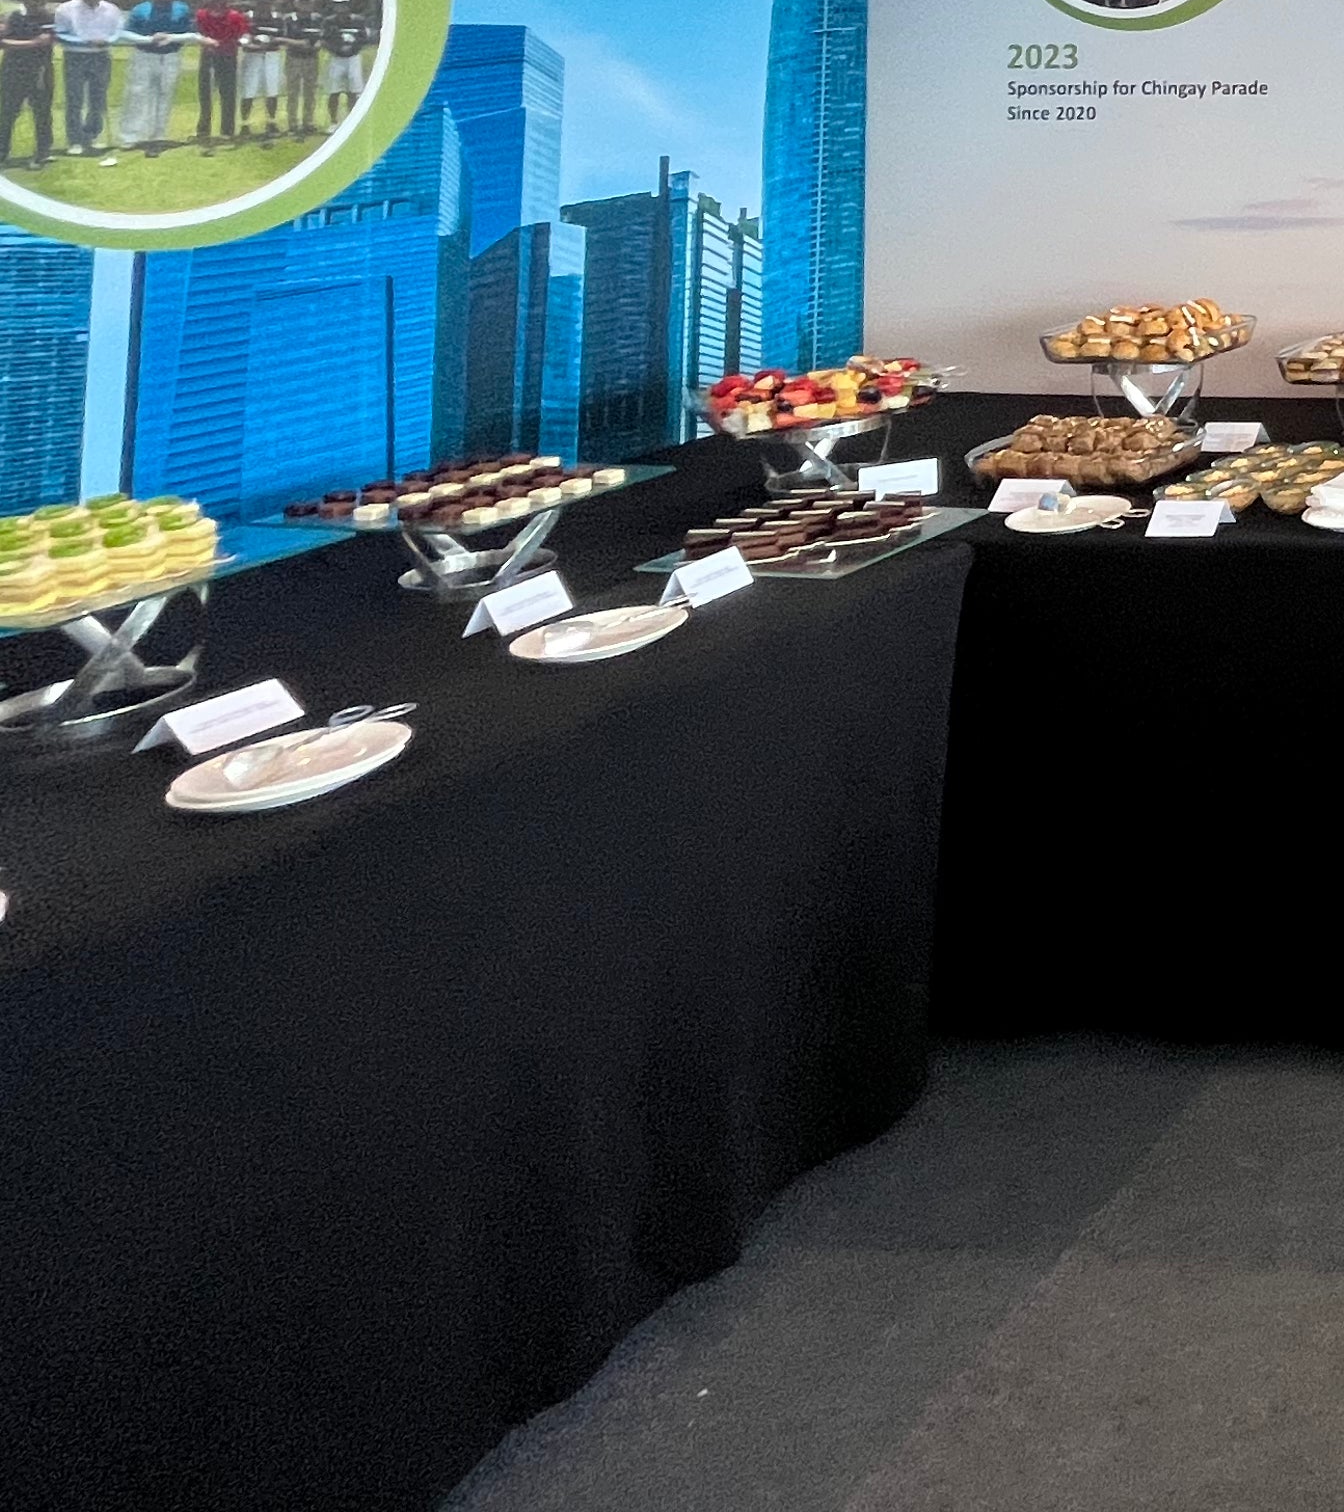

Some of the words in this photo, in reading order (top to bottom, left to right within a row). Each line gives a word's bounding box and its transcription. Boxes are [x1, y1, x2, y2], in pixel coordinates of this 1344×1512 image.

[1007, 43, 1078, 69] 2023
[1007, 80, 1107, 98] Sponsorship
[1113, 80, 1136, 95] for
[1142, 80, 1206, 98] Chingay
[1212, 80, 1268, 95] Parade
[1007, 106, 1049, 120] Since
[1056, 106, 1096, 120] 2020
